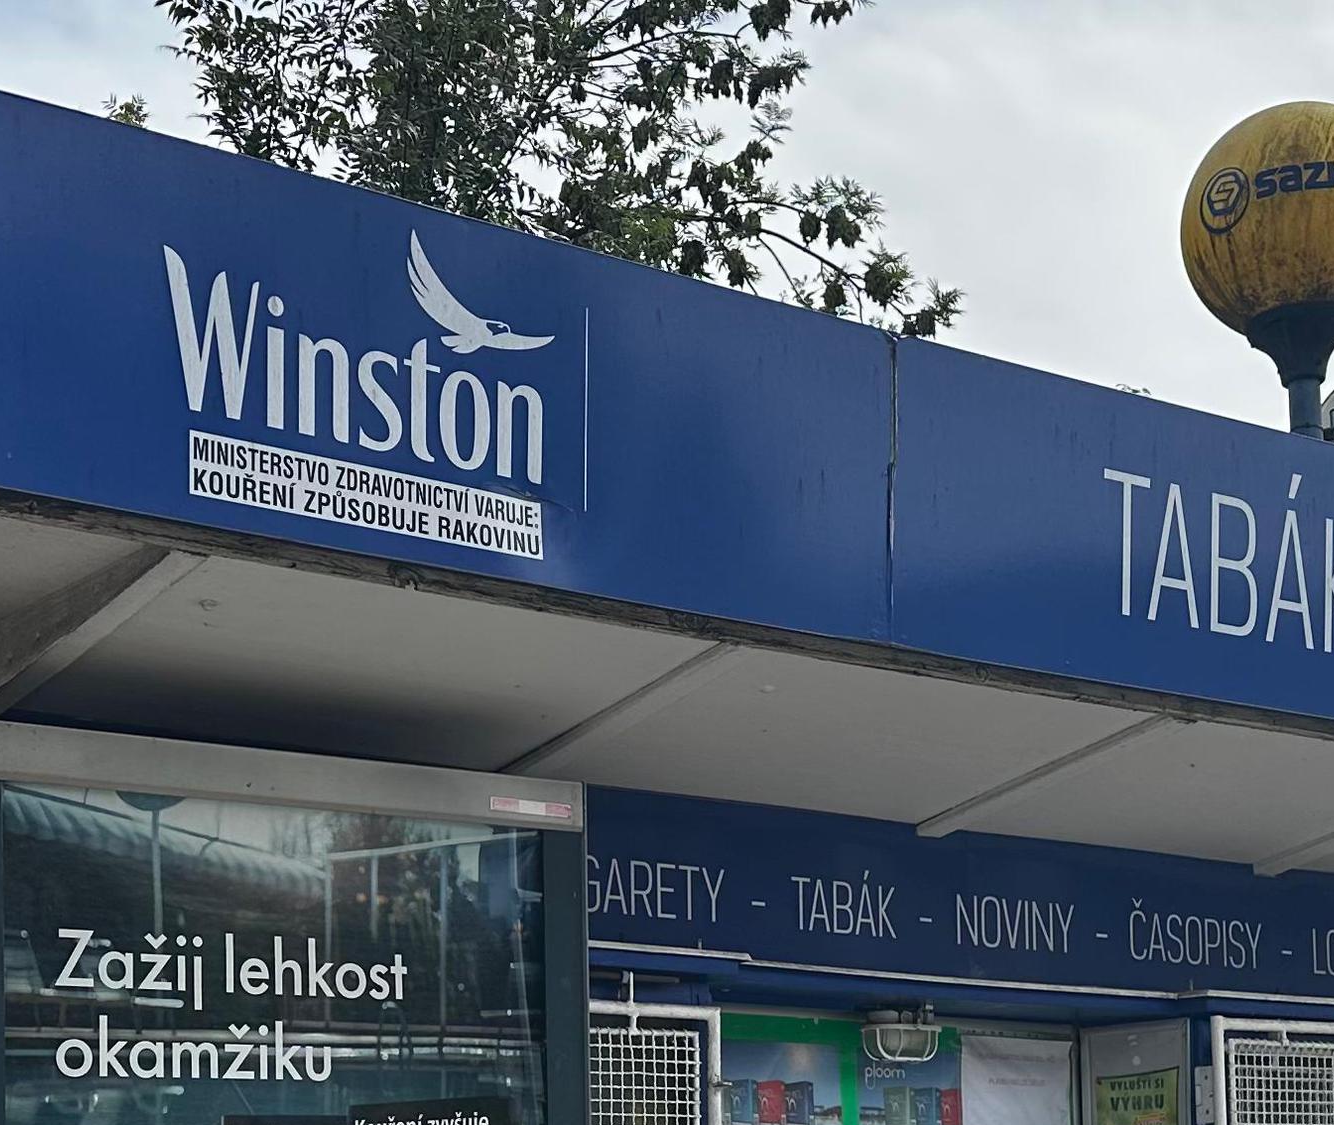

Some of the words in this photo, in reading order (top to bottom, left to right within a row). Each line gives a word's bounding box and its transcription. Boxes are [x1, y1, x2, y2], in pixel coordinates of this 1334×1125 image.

[163, 244, 543, 484] Winston
[193, 437, 329, 486] MINISTERSTVO
[336, 466, 470, 514] ZDRAVOTNICTVÍ
[474, 494, 539, 529] VARUJE:
[193, 467, 296, 510] KOUŘENÍ
[304, 490, 429, 534] ZPŮSOBUJE
[438, 516, 540, 555] RAKOVINU
[791, 870, 897, 939] TABÁK
[956, 893, 1074, 953] NOVINY
[1129, 897, 1262, 969] ČASOPISY
[56, 929, 203, 1010] Zažij
[225, 932, 408, 1000] lehkost
[56, 1015, 333, 1083] okamžiku
